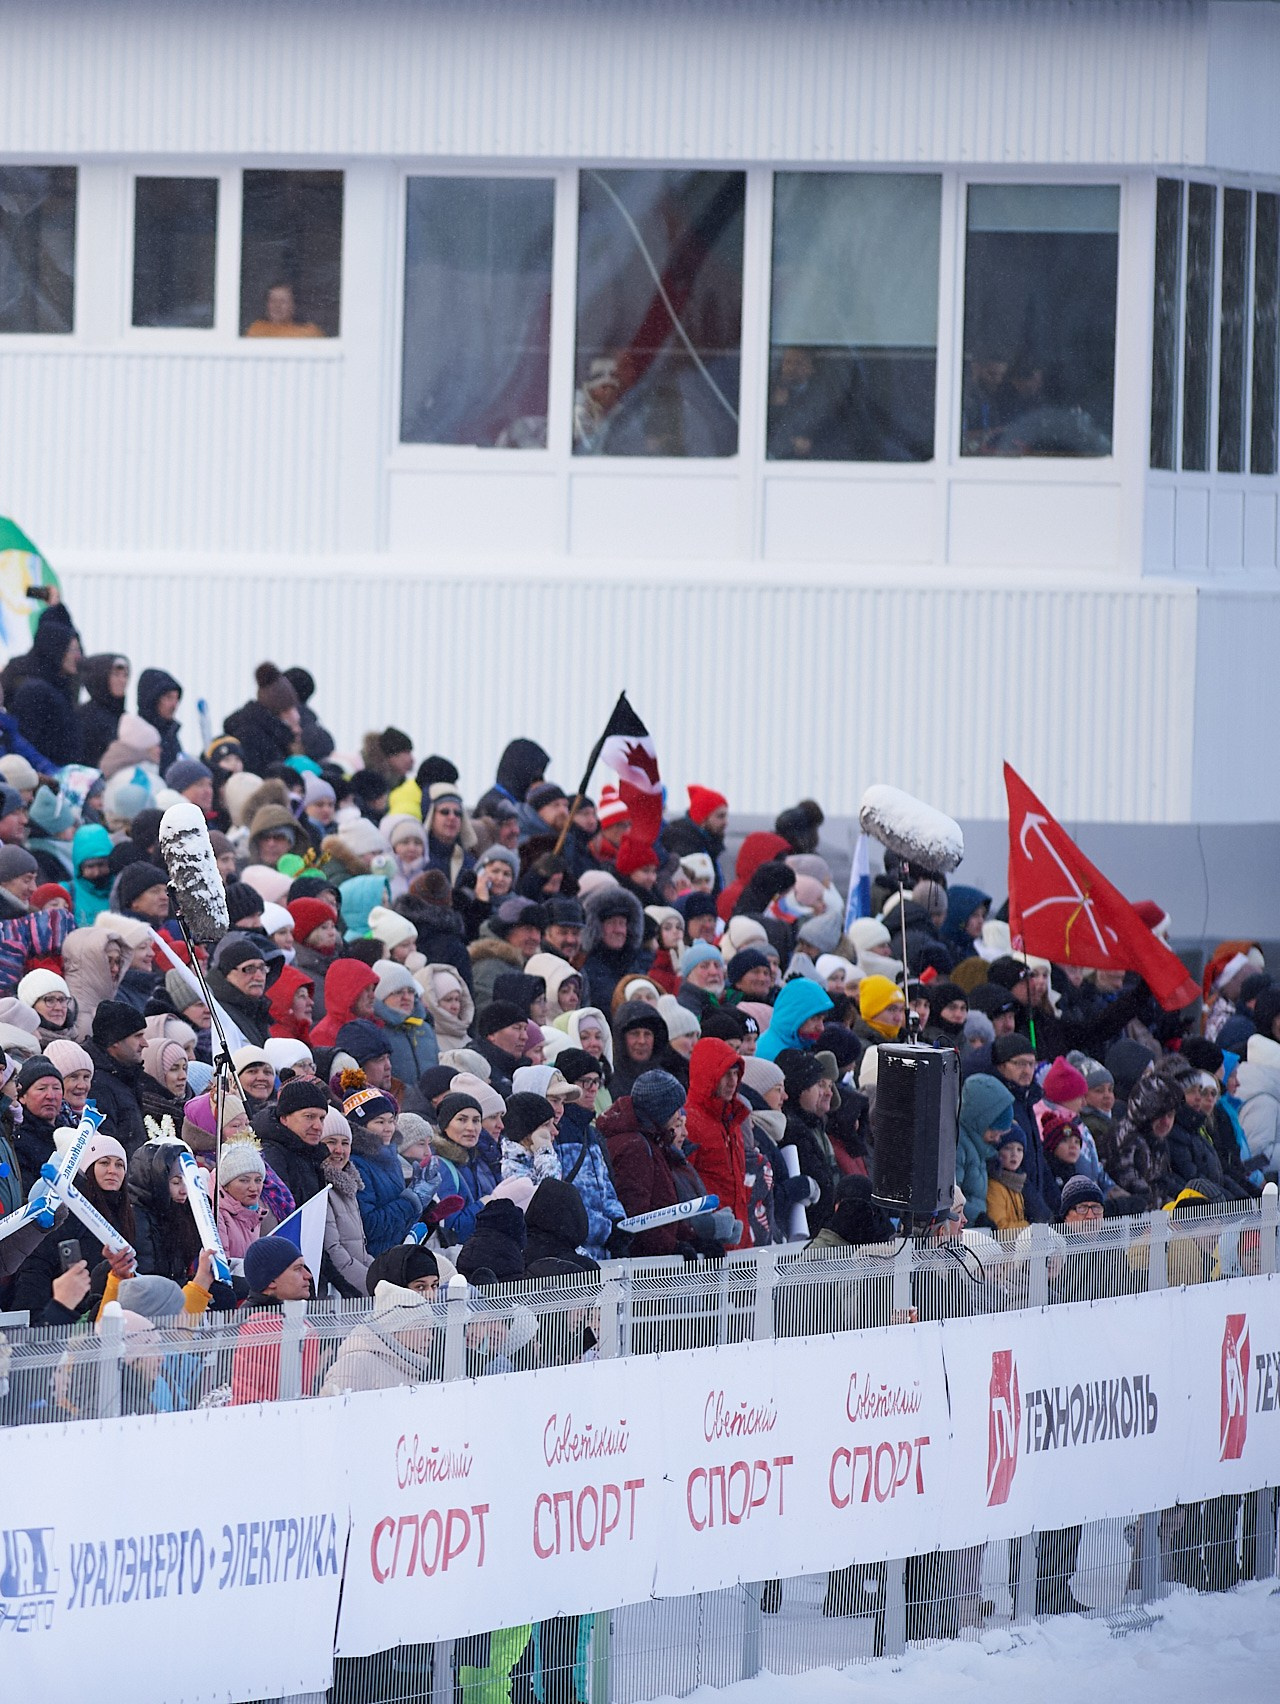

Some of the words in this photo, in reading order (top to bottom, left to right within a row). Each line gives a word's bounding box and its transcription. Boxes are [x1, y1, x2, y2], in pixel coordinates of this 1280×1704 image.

[1025, 1374, 1158, 1454] ТЕХНОНИКОЛЬ
[686, 1455, 794, 1531] СПОРТ
[829, 1436, 931, 1509] СПОРТ
[370, 1503, 490, 1584] СПОРТ
[533, 1479, 645, 1559] СПОРТ
